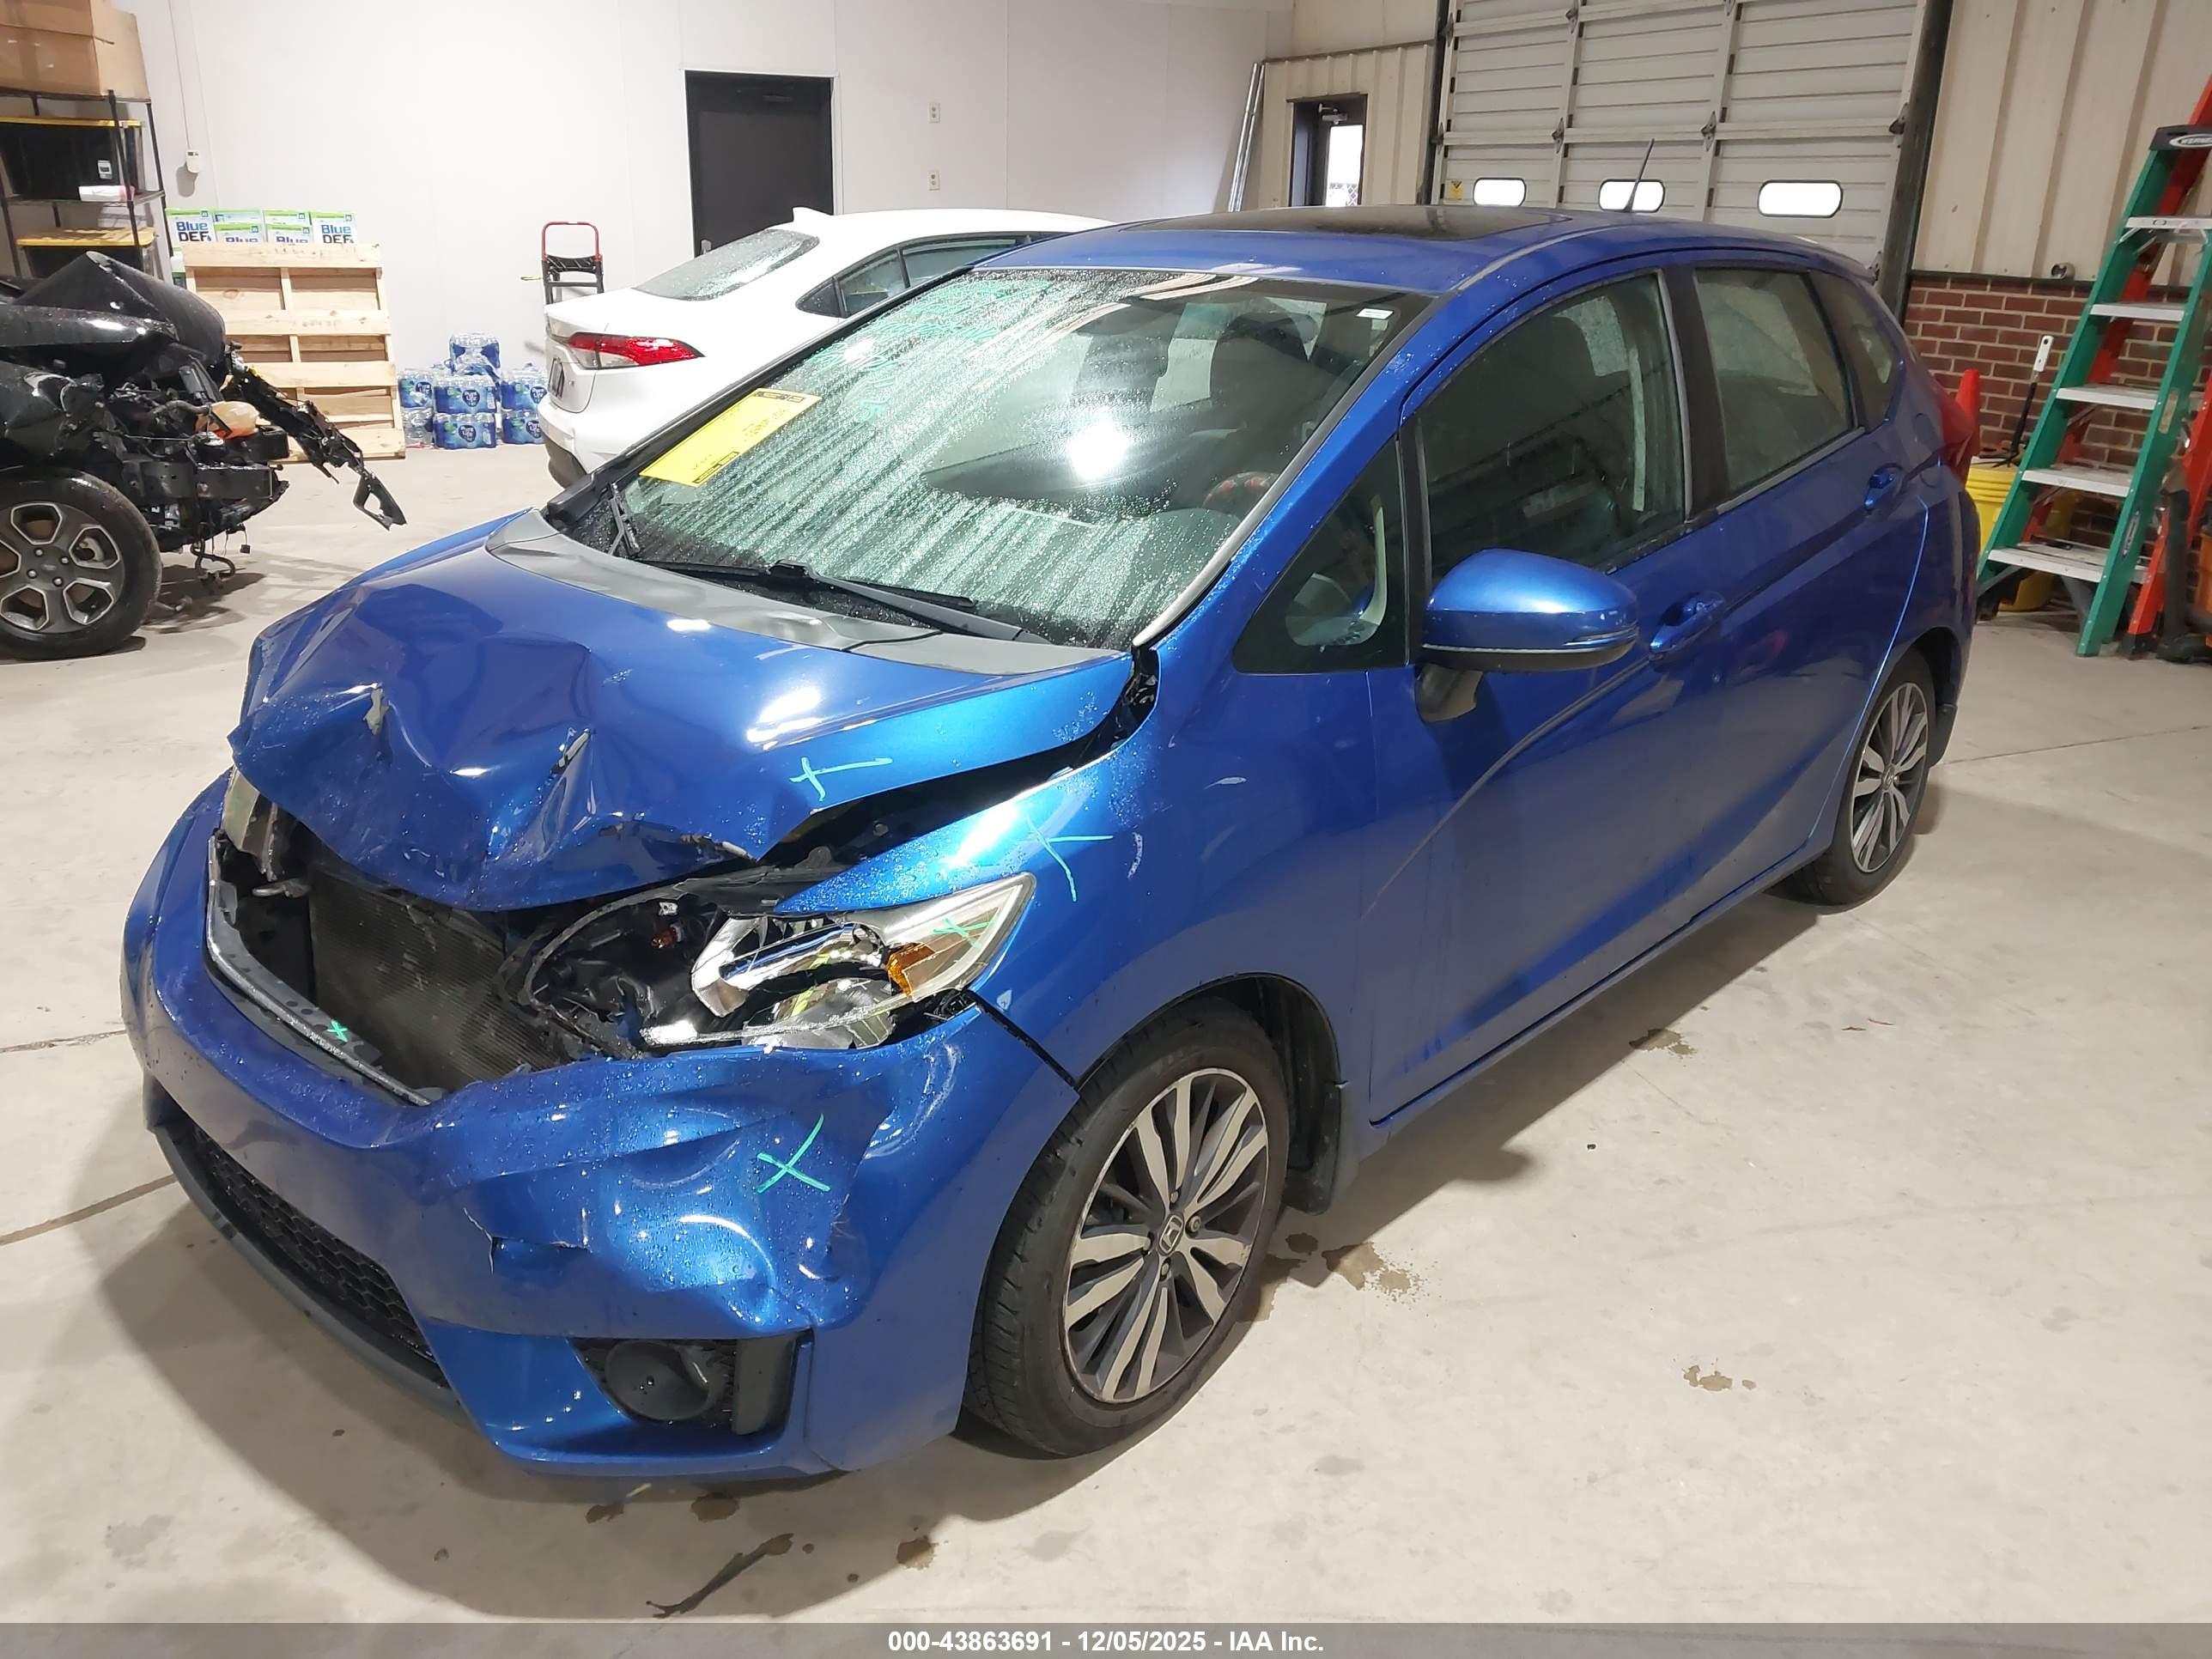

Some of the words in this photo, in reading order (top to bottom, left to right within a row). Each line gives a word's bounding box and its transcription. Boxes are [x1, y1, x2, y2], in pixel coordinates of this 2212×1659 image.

[176, 222, 209, 231] Blue
[321, 224, 351, 234] Blue
[178, 231, 209, 242] DEF
[322, 234, 352, 244] DEF
